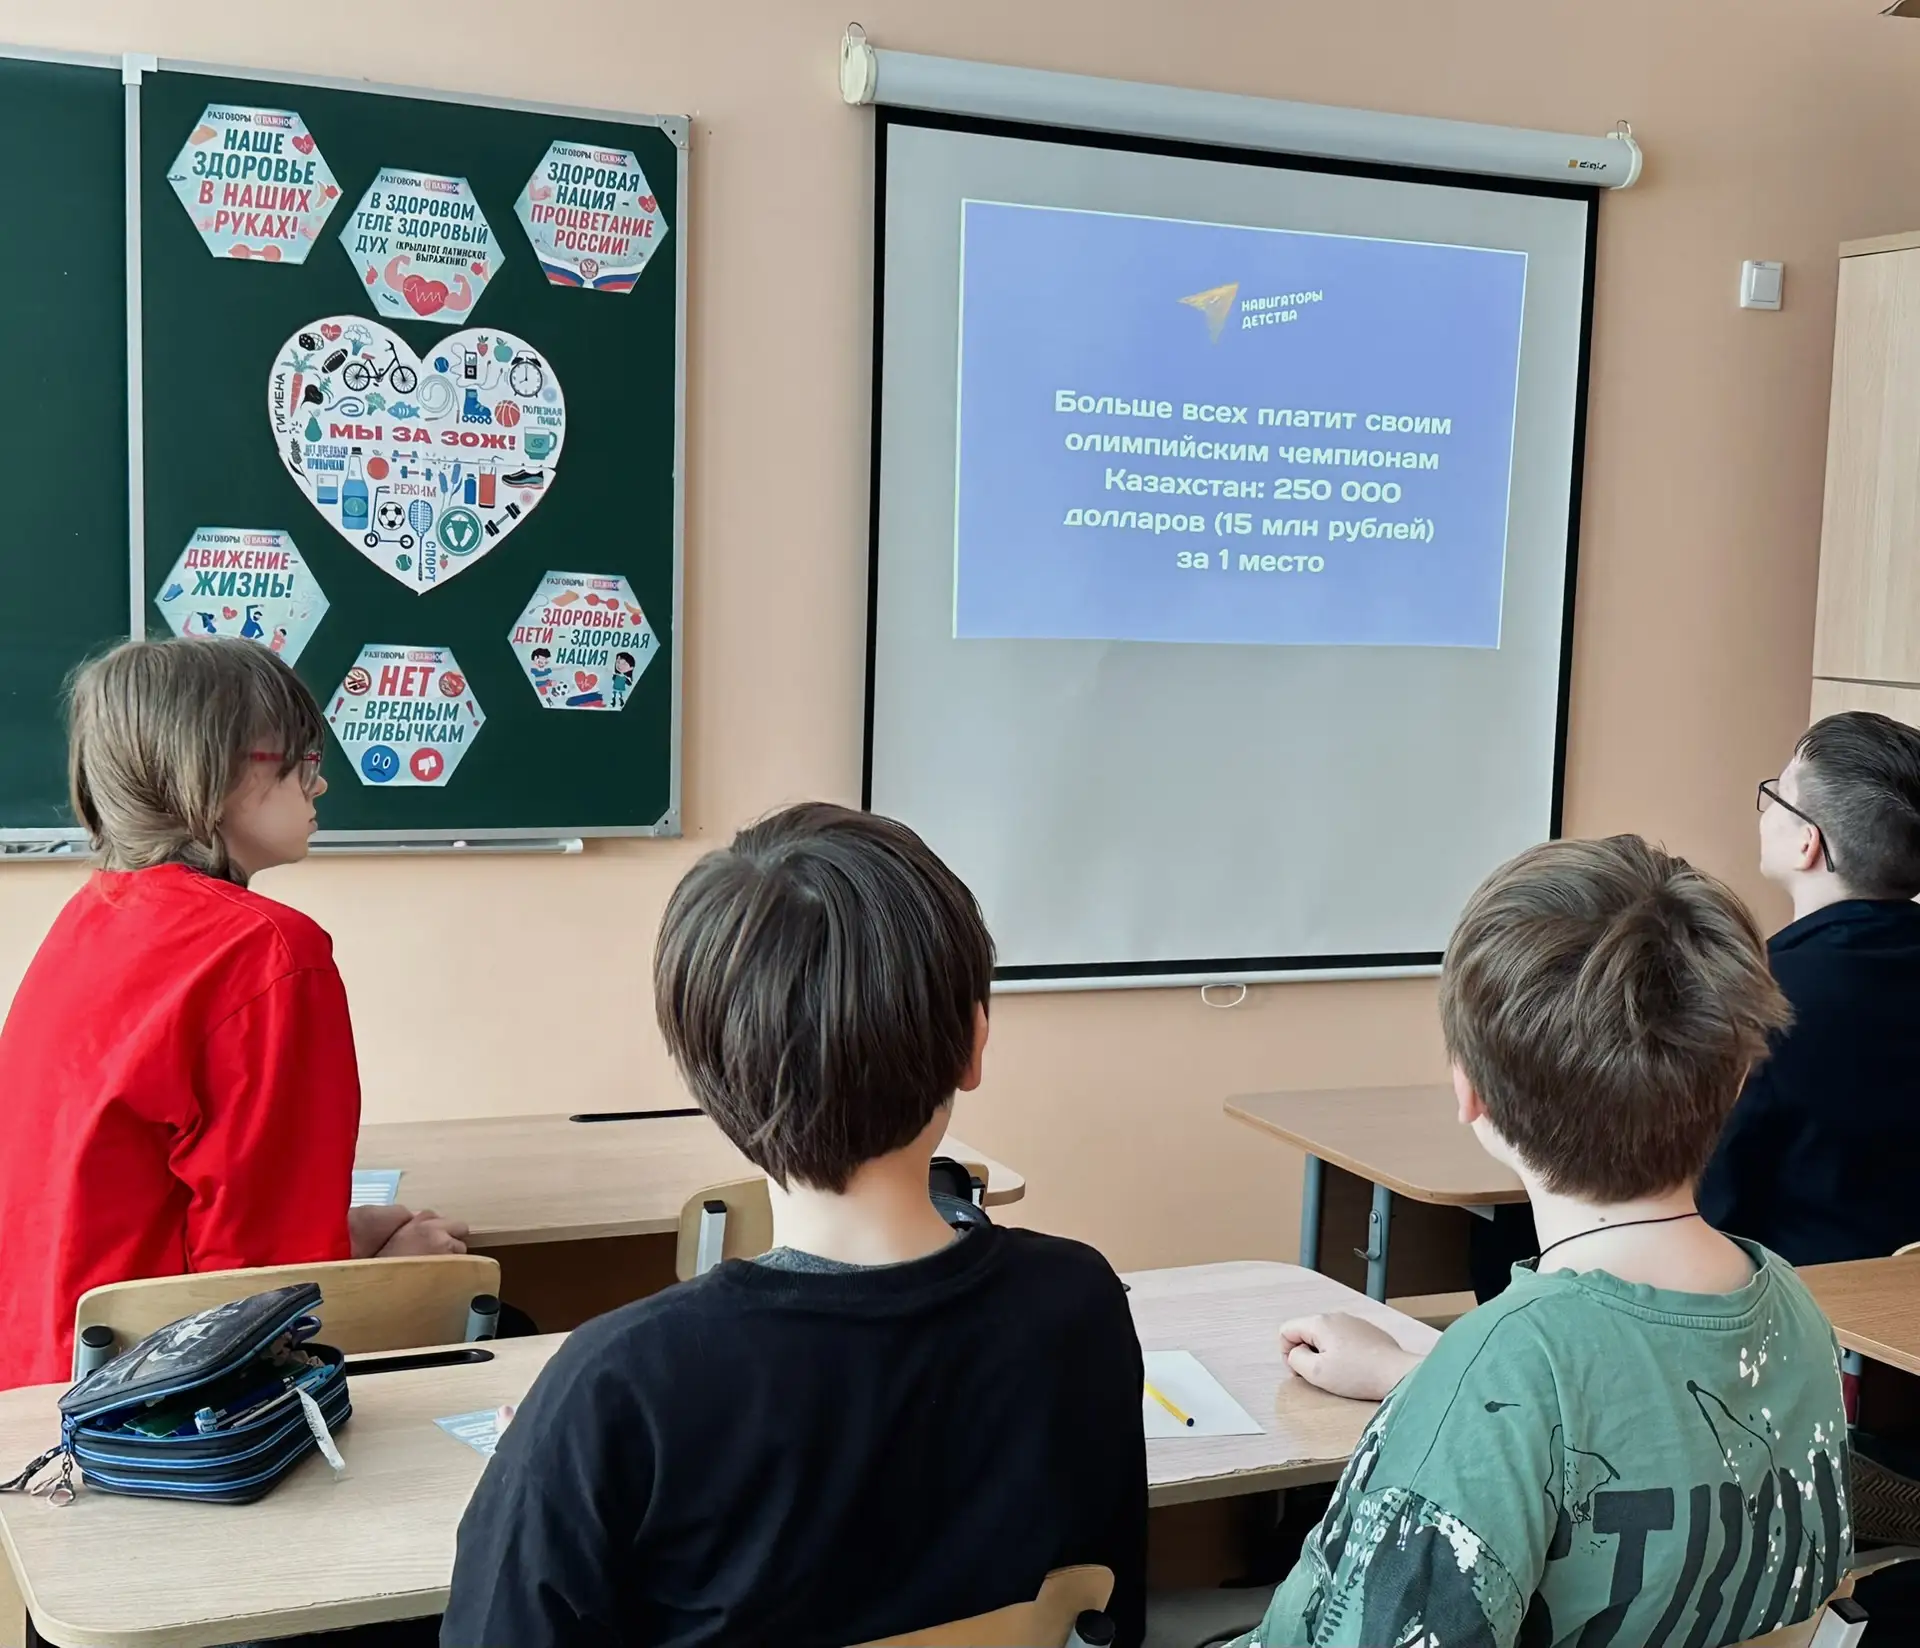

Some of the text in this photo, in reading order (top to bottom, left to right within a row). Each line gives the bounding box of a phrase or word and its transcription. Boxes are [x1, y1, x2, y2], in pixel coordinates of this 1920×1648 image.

[207, 111, 252, 123] РАЗГОВОРЫ
[262, 116, 296, 128] ВАЖНО
[223, 128, 285, 154] НАШЕ
[192, 151, 317, 185] ЗДОРОВЬЕ
[380, 175, 421, 187] РАЗГОВОРЫ
[547, 162, 640, 192] ЗДОРОВАЯ
[198, 180, 312, 213] В НАШИХ
[370, 192, 475, 221] В ЗДОРОВОМ
[556, 185, 617, 211] НАЦИЯ
[214, 210, 299, 240] РУКАХ!
[357, 212, 490, 244] ТЕЛЕ ЗДОРОВЫЙ
[530, 204, 655, 238] ПРОЦВЕТАНИЕ
[355, 234, 487, 260] ДУХ (КРЫЛАТОЕ ЛАТИНСКОЕ
[554, 229, 630, 256] РОССИИ!
[415, 252, 467, 267] ВЫРАЖЕНИЕ)
[1241, 289, 1323, 312] НАВИГАТОРЫ
[1241, 309, 1298, 330] ДЕТСТВА
[274, 372, 288, 433] ГИГИЕНА
[1054, 390, 1452, 435] Больше всех платит своим
[329, 423, 516, 450] МЫ ЗА ЗОЖ!
[1065, 432, 1440, 470] олимпийским чемпионам
[394, 483, 437, 498] РЕЖИМ
[1105, 468, 1402, 504] Казахстан: 250 000
[196, 533, 241, 544] РАЗГОВОРЫ
[1063, 507, 1435, 543] долларов (15 млн рублей)
[425, 541, 437, 582] СПОРТ
[1176, 549, 1325, 573] за 1 место
[191, 570, 294, 598] ЖИЗНЬ!
[541, 607, 626, 628] ЗДОРОВЫЕ
[512, 626, 554, 644] ДЕТИ
[570, 629, 651, 649] ЗДОРОВАЯ
[556, 647, 609, 667] НАЦИЯ
[377, 665, 436, 697] НЕТ
[364, 700, 460, 723] ВРЕДНЫМ
[342, 721, 465, 742] ПРИВЫЧКАМ
